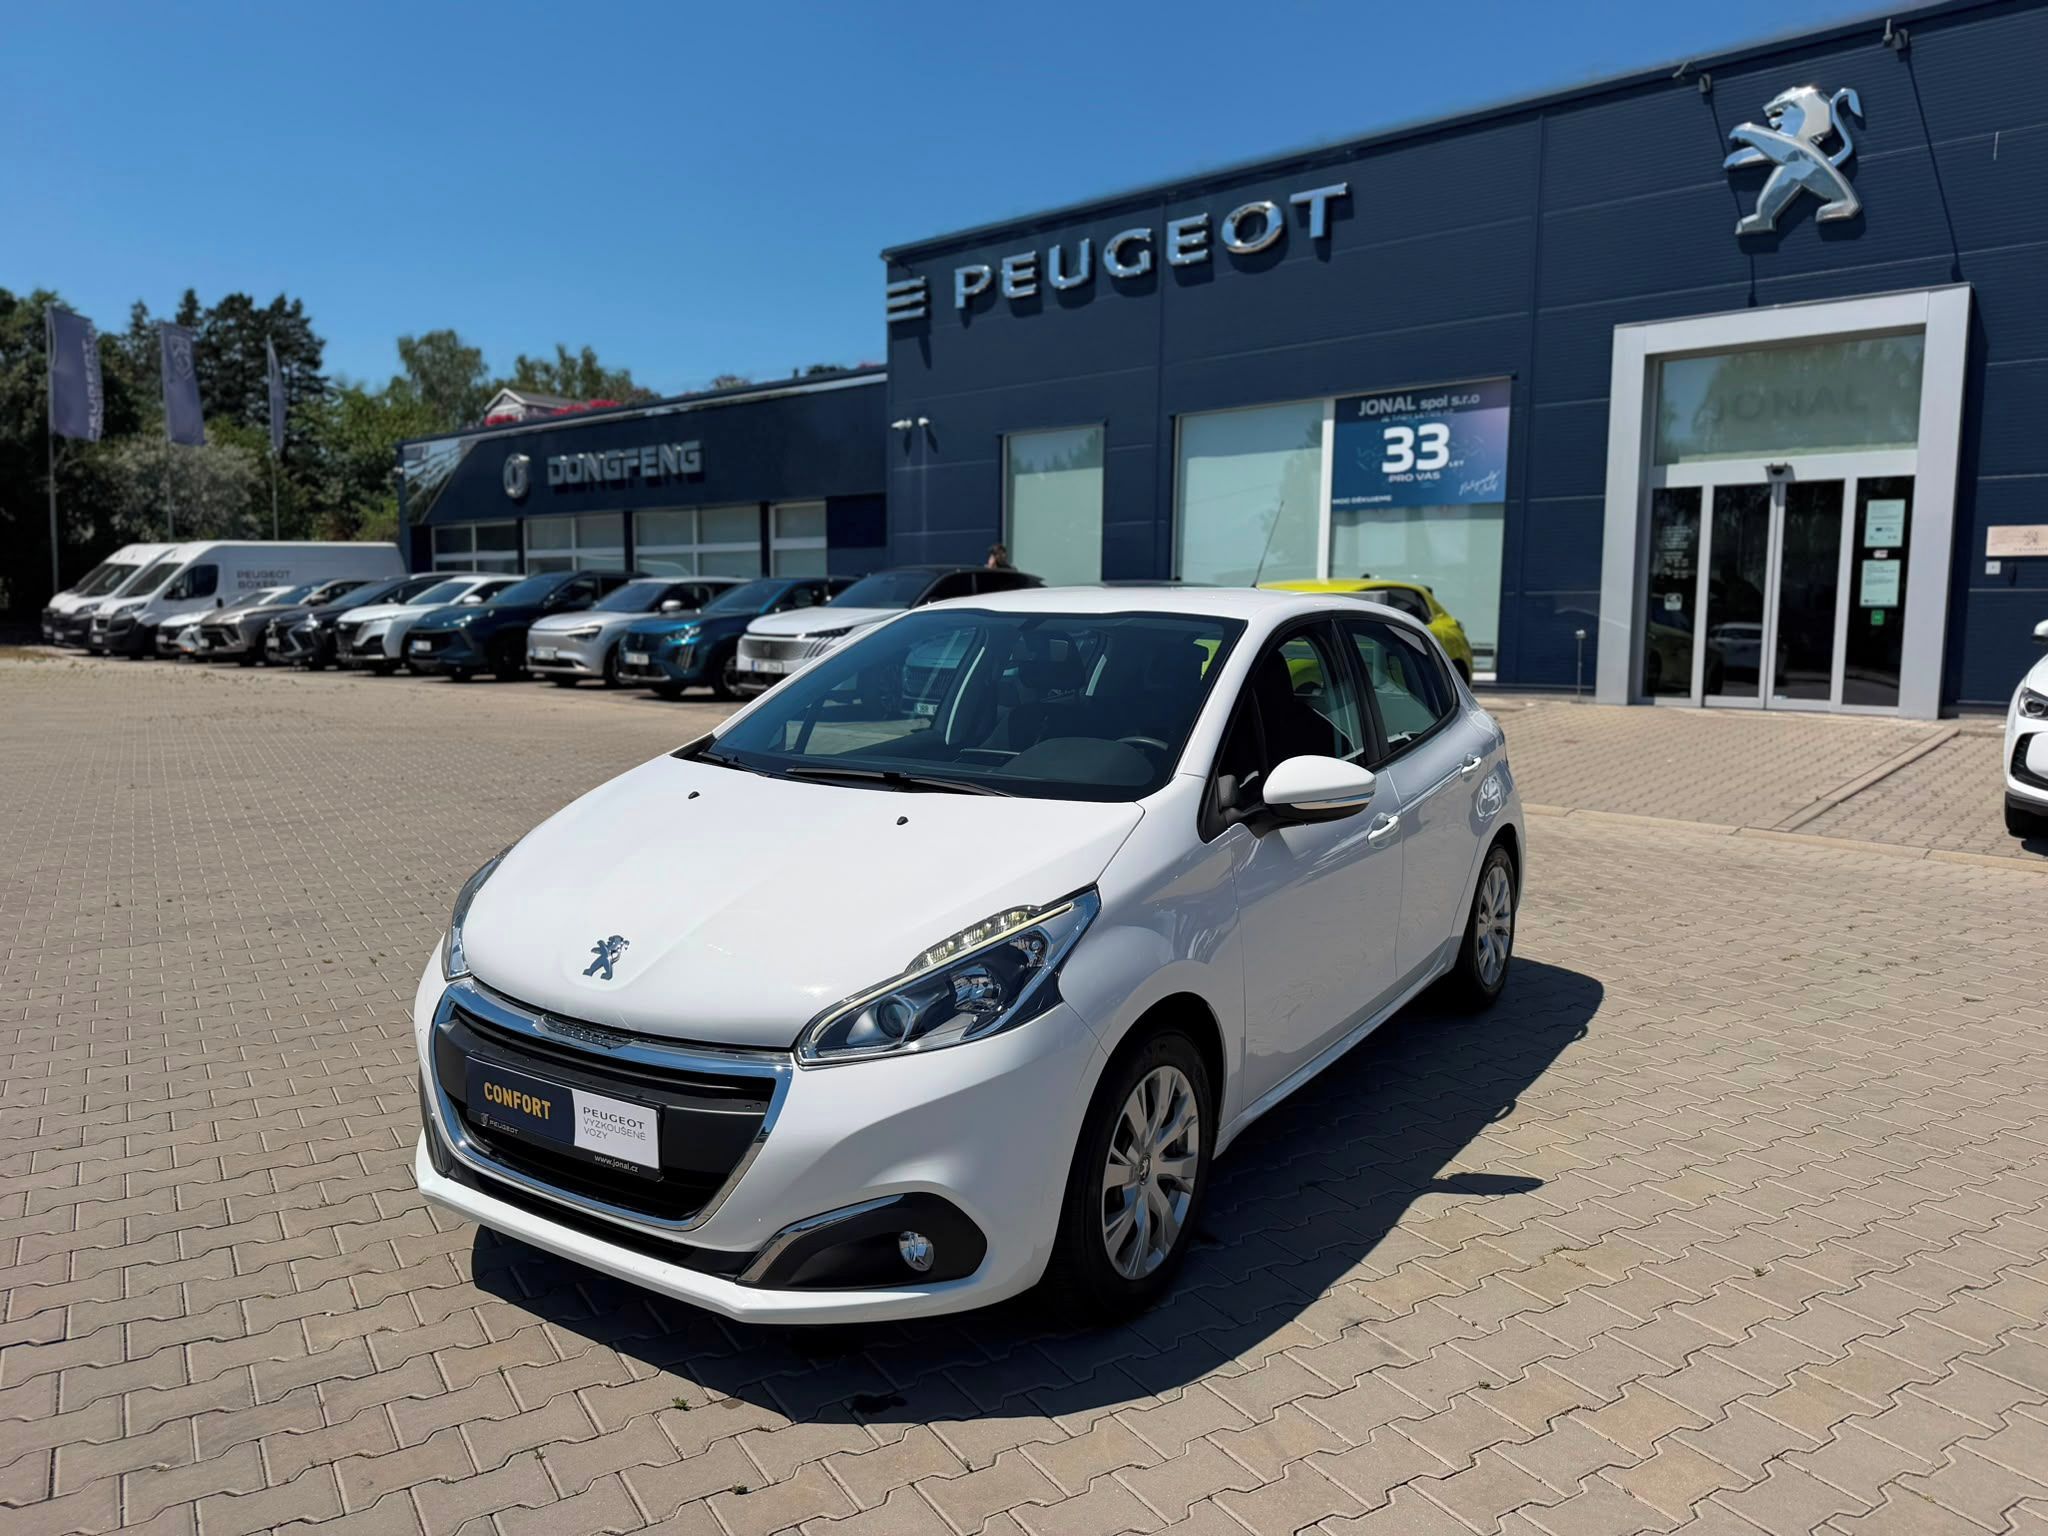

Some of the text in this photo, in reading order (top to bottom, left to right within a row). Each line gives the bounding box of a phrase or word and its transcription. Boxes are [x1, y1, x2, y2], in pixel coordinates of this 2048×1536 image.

[954, 182, 1349, 310] PEUGEOT
[1358, 396, 1416, 416] JONAL
[1420, 395, 1448, 411] spol
[1382, 423, 1450, 474] 33
[547, 440, 701, 486] DONGFENG
[1388, 474, 1414, 482] PRO
[237, 570, 290, 579] PEUGEOT
[483, 1081, 551, 1121] CONFORT
[488, 1120, 519, 1135] PEUGEOT
[583, 1106, 645, 1130] PEUGEOT
[583, 1116, 647, 1141] VYZKOUŠENÉ
[583, 1126, 608, 1140] VOZY
[594, 1153, 640, 1174] www.jonal.cz
